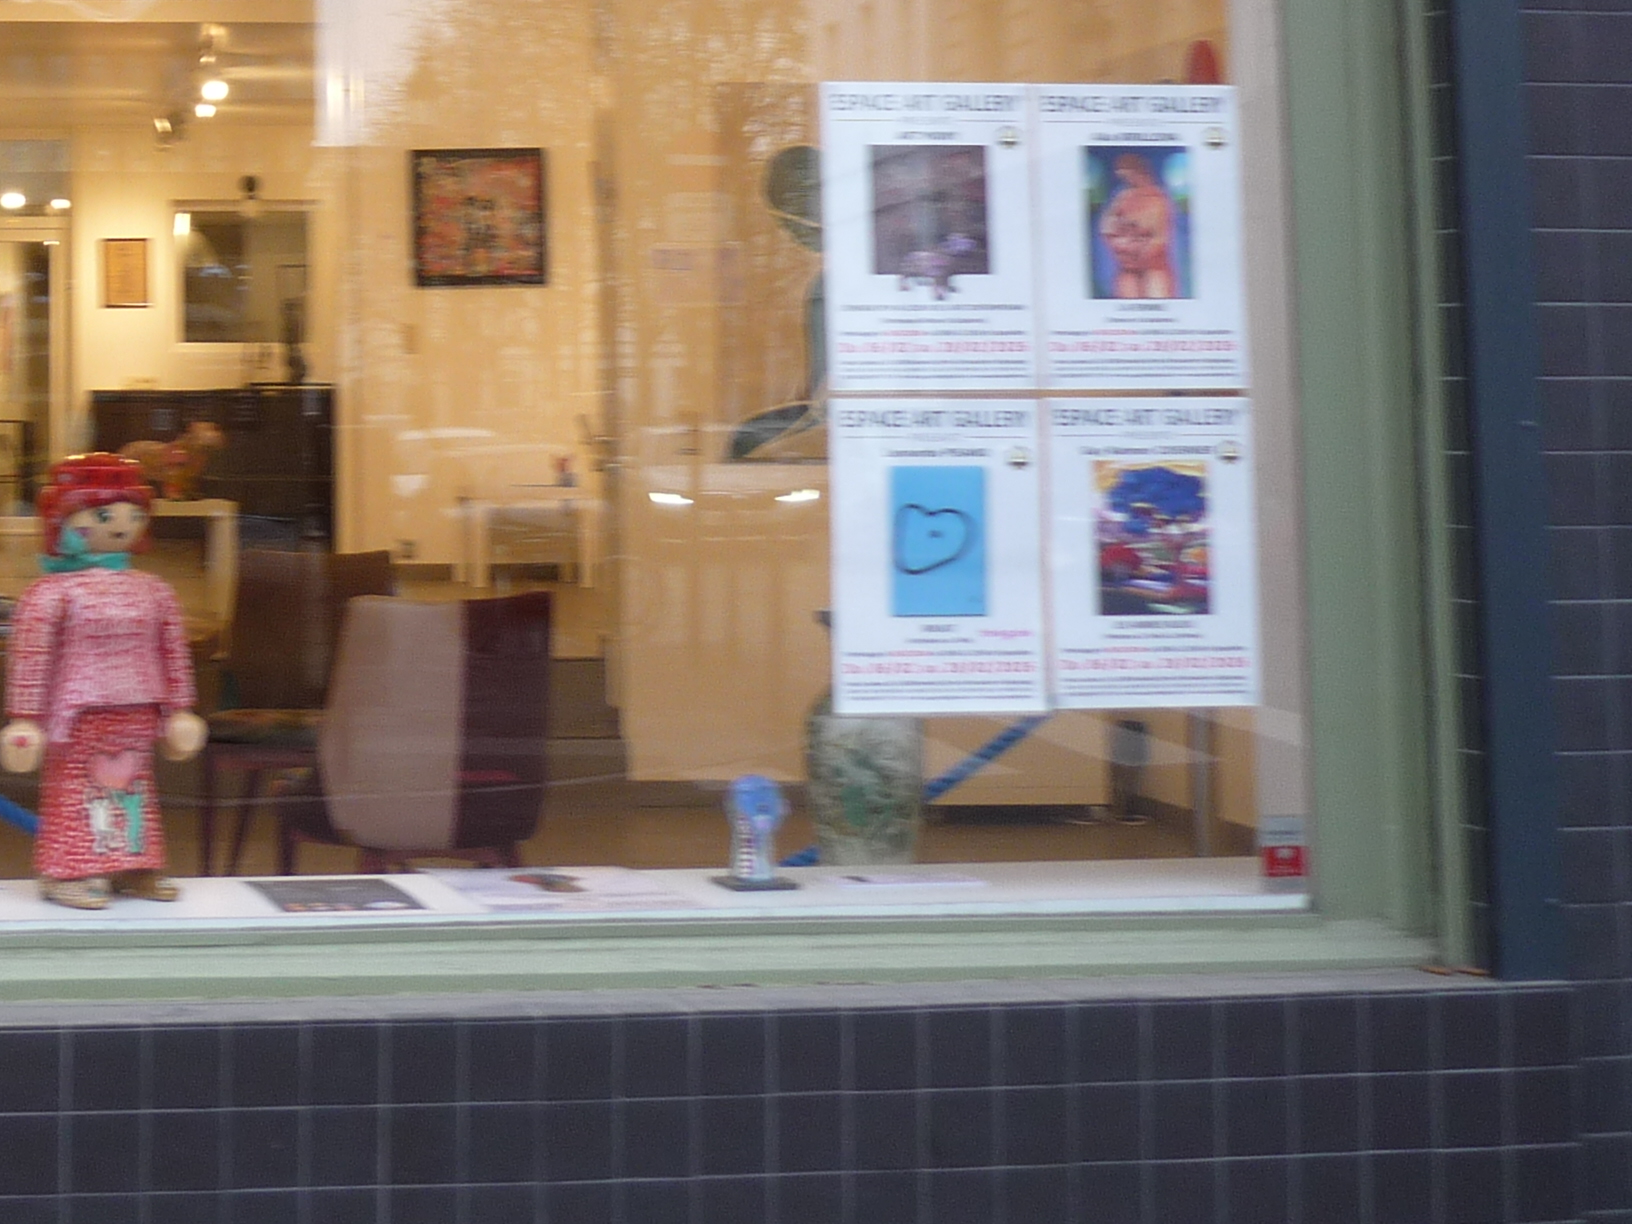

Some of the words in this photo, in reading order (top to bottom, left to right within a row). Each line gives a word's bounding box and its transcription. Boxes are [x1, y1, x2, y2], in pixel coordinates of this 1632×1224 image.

[829, 94, 900, 111] ESPACE
[903, 94, 938, 111] ART
[942, 94, 1018, 112] GALLERY
[1039, 96, 1109, 113] ESPACE
[1111, 96, 1146, 113] ART
[1149, 96, 1222, 113] GALLERY
[838, 410, 910, 427] ESPACE
[912, 410, 948, 427] ART
[953, 410, 1027, 427] GALLERY
[1053, 409, 1124, 426] ESPACE
[1125, 409, 1161, 426] ART
[1164, 408, 1236, 426] GALLERY
